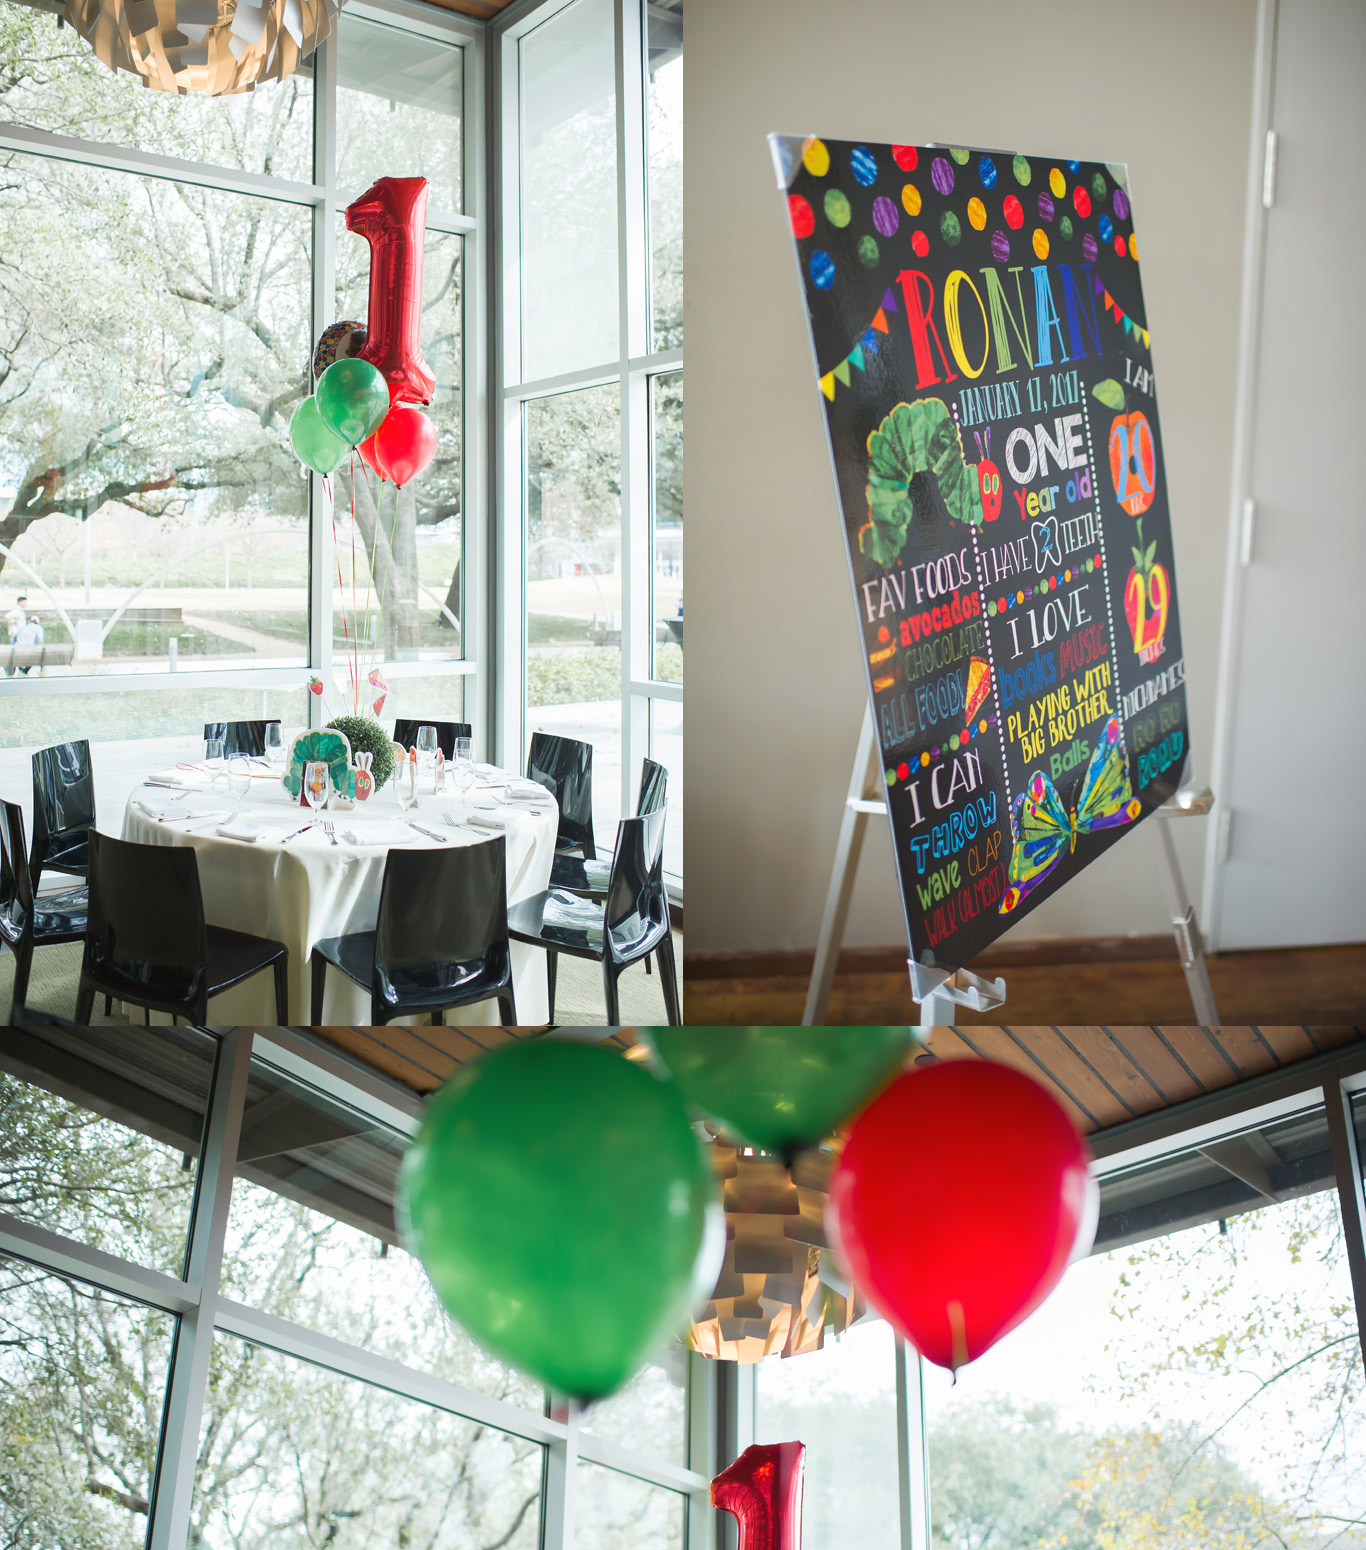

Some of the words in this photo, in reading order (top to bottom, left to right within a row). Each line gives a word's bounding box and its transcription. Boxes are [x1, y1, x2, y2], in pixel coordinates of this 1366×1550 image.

[896, 264, 1102, 390] RONAN
[959, 380, 1022, 427] JANUARY
[1026, 377, 1048, 413] 17,
[1050, 370, 1079, 407] 2017
[1124, 357, 1132, 384] I
[1132, 365, 1155, 397] AM
[1005, 413, 1088, 484] ONE
[1111, 420, 1156, 503] 20
[1013, 485, 1059, 520] Year
[1065, 468, 1092, 503] old
[861, 570, 906, 623] FAV
[911, 548, 971, 604] FOODS
[980, 551, 991, 587] I
[991, 536, 1032, 582] HAVE
[1039, 526, 1053, 553] 2
[1060, 511, 1100, 554] TEETH
[899, 590, 980, 647] avocados
[1006, 617, 1023, 659] I
[1027, 584, 1092, 649] LOVE
[1129, 564, 1167, 654] 29
[904, 621, 985, 681] CHOCOLATE
[999, 649, 1057, 709] books
[1060, 621, 1108, 678] MUSIC
[881, 694, 915, 750] ALL
[915, 668, 965, 731] FOOD!
[1007, 684, 1070, 743] PLAYING
[1073, 660, 1111, 703] WITH
[1021, 727, 1046, 764] BIG
[1048, 690, 1114, 747] BROTHER
[904, 781, 925, 829] I
[931, 746, 983, 810] CAN
[1050, 738, 1090, 781] Balls
[910, 790, 997, 874] THROW
[917, 860, 961, 911] wave
[967, 830, 1002, 877] CLAP
[924, 906, 957, 948] WALK
[958, 862, 1006, 923] (ALMOST)
